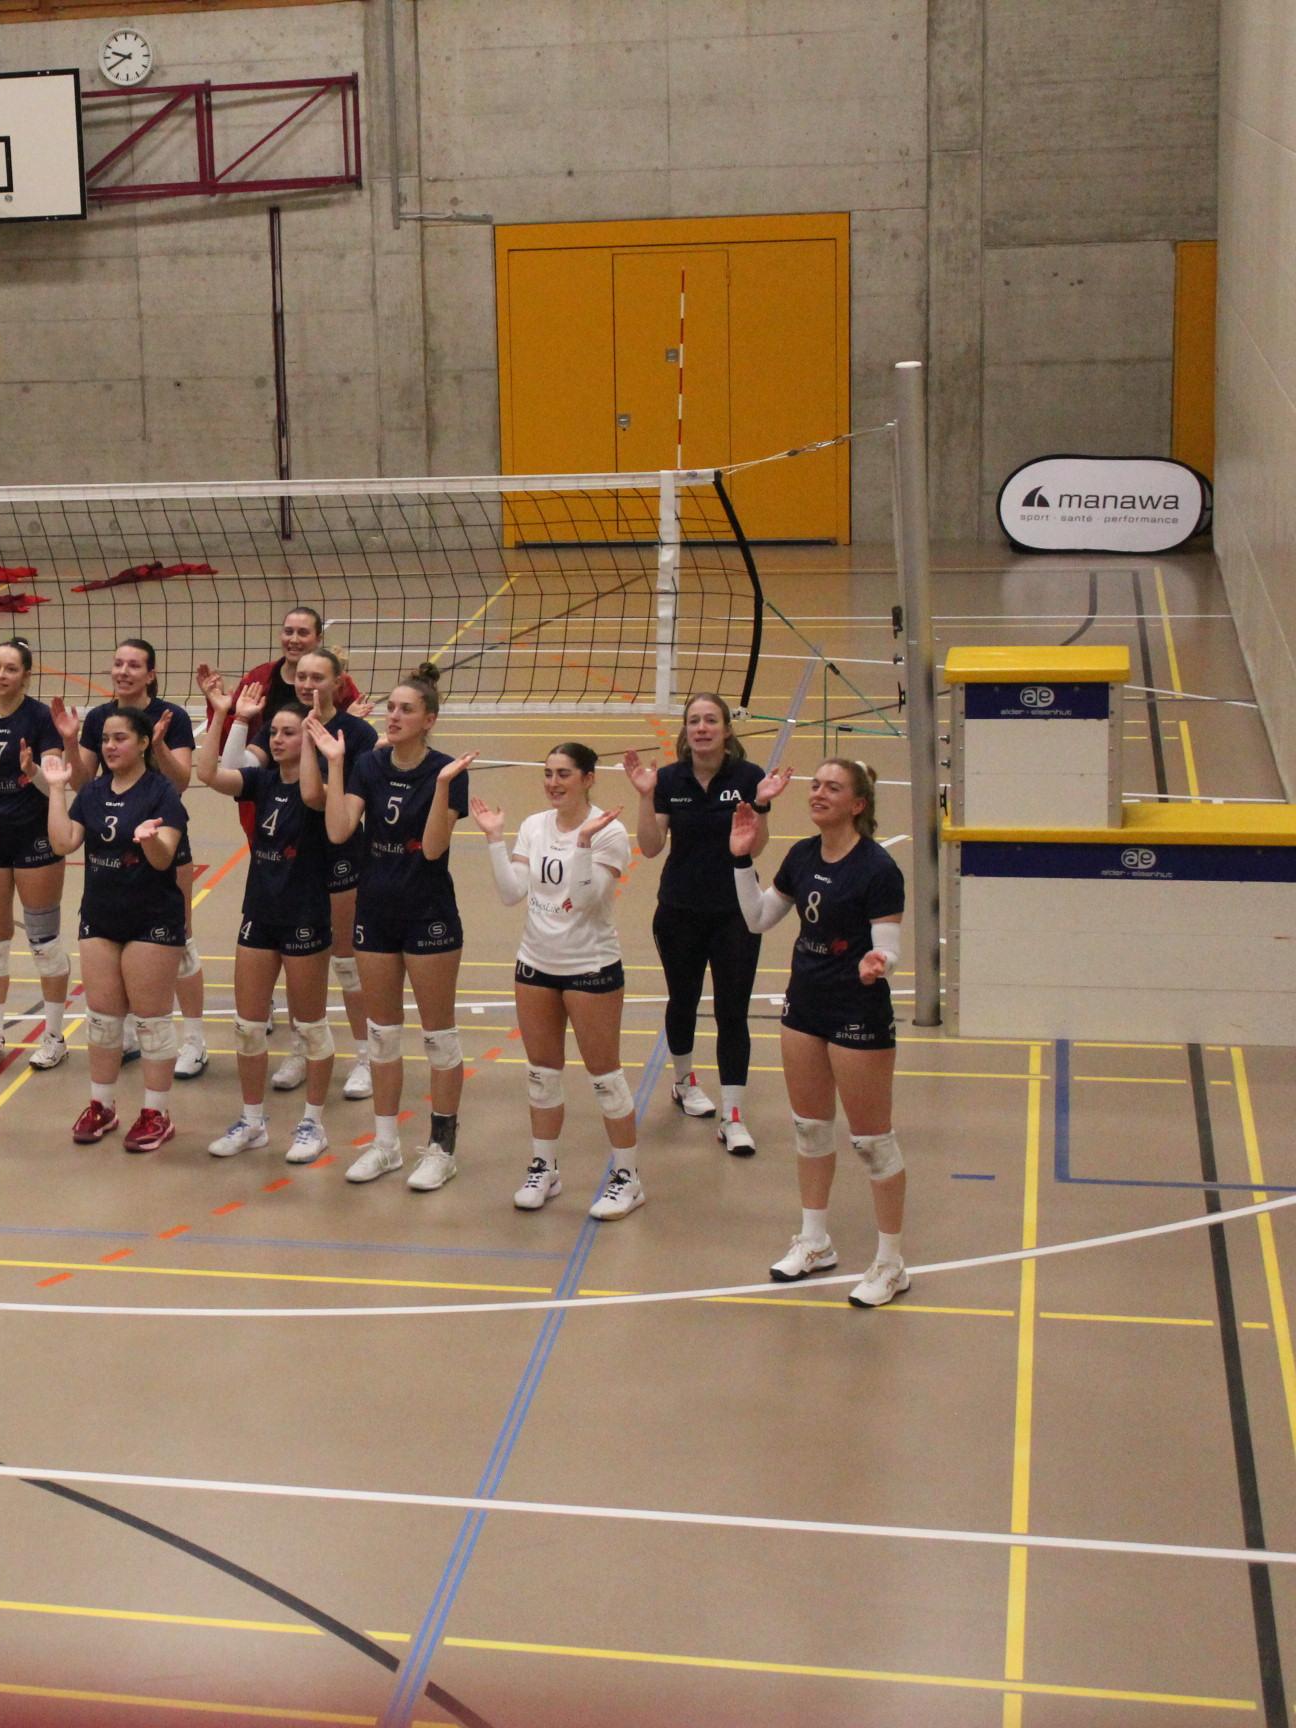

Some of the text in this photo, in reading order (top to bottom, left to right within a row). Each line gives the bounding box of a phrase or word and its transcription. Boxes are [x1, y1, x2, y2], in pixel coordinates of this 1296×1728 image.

[1058, 493, 1180, 510] manawa
[1020, 513, 1178, 524] sport santé performance
[262, 808, 279, 836] 4
[384, 796, 403, 825] 5
[100, 815, 118, 842] 3
[541, 856, 563, 885] 10
[805, 891, 821, 923] 8
[240, 920, 252, 940] 4
[356, 924, 364, 944] 5
[835, 1031, 875, 1040] SINGER
